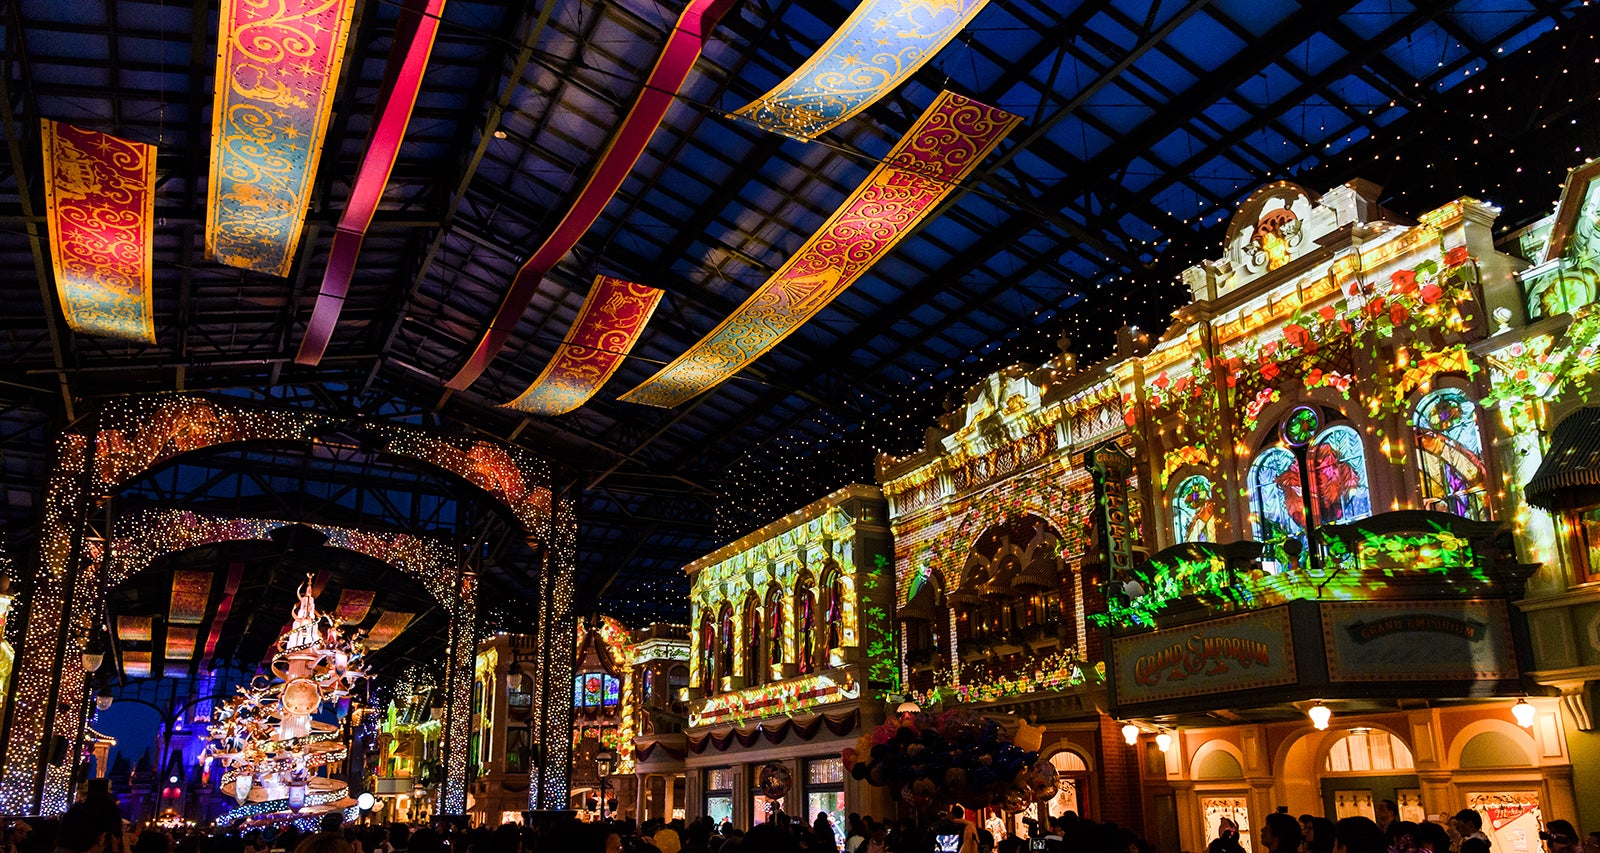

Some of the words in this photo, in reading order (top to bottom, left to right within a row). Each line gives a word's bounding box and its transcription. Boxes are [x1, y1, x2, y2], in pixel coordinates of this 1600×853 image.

[1360, 619, 1401, 639] GRAND
[1407, 617, 1475, 638] EMPORIUM
[1135, 643, 1183, 685] GRAND
[1184, 633, 1270, 673] EMPORIUM
